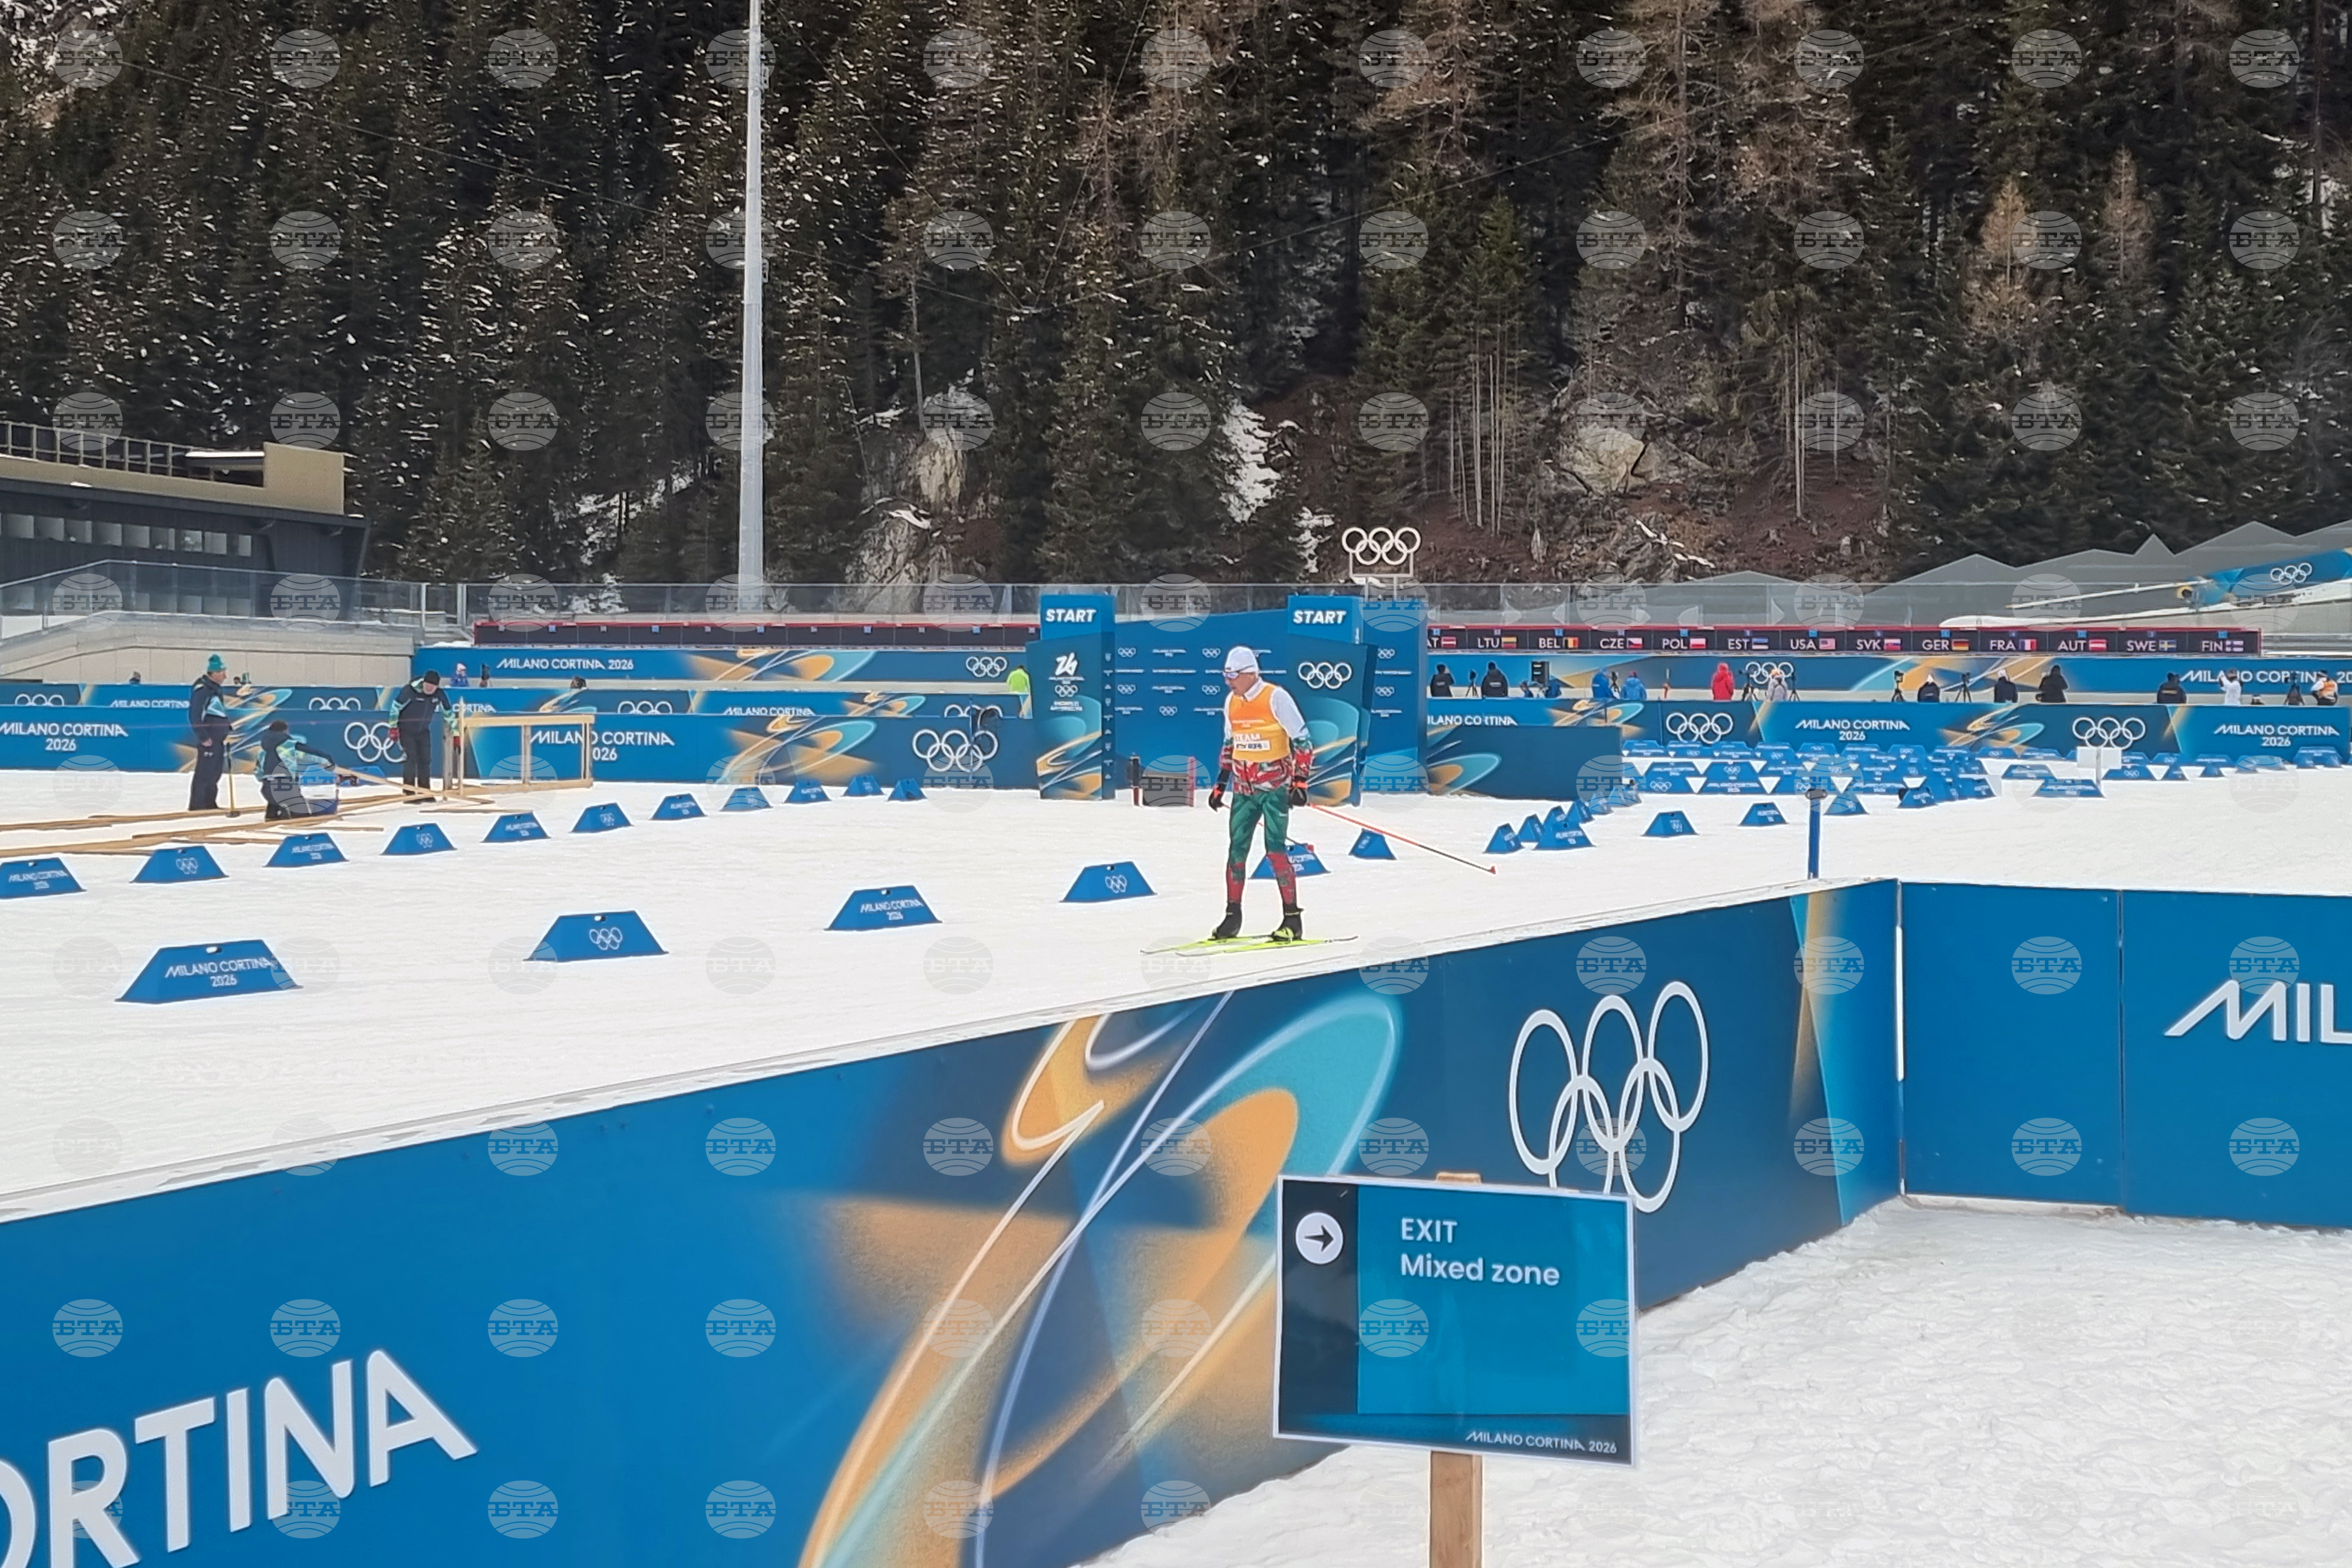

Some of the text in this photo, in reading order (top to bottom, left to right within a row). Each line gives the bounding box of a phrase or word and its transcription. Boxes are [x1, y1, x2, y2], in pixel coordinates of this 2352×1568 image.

[1045, 609, 1097, 623] START
[1293, 610, 1347, 624] START
[1477, 638, 1500, 649] LTU
[1539, 638, 1561, 649] BEL
[1600, 638, 1625, 649] CZE
[1663, 638, 1688, 649] POL
[1728, 638, 1749, 650] EST
[1790, 639, 1816, 650] USA
[1856, 639, 1881, 650] SVK
[1922, 640, 1949, 650] GER
[1990, 640, 2016, 650] FRA
[2058, 640, 2087, 650] AUT
[2126, 640, 2156, 652] SWE
[2201, 640, 2223, 652] FIN
[496, 659, 634, 670] MILANO CORTINA 2026
[62, 723, 129, 737] CORTINA
[1795, 719, 1910, 730] MILANO CORTINA
[2214, 724, 2340, 736] MILANO CORTINA
[602, 731, 675, 746] CORTINA
[1839, 731, 1866, 740] 2026
[45, 738, 76, 751] 2026
[2261, 737, 2291, 747] 2026
[592, 747, 618, 761] 026
[164, 957, 275, 978] MILANO CORTINA
[1401, 1217, 1458, 1243] EXIT
[1401, 1252, 1560, 1286] Mixed zone
[1465, 1431, 1617, 1454] MILANO CORTINA 2026
